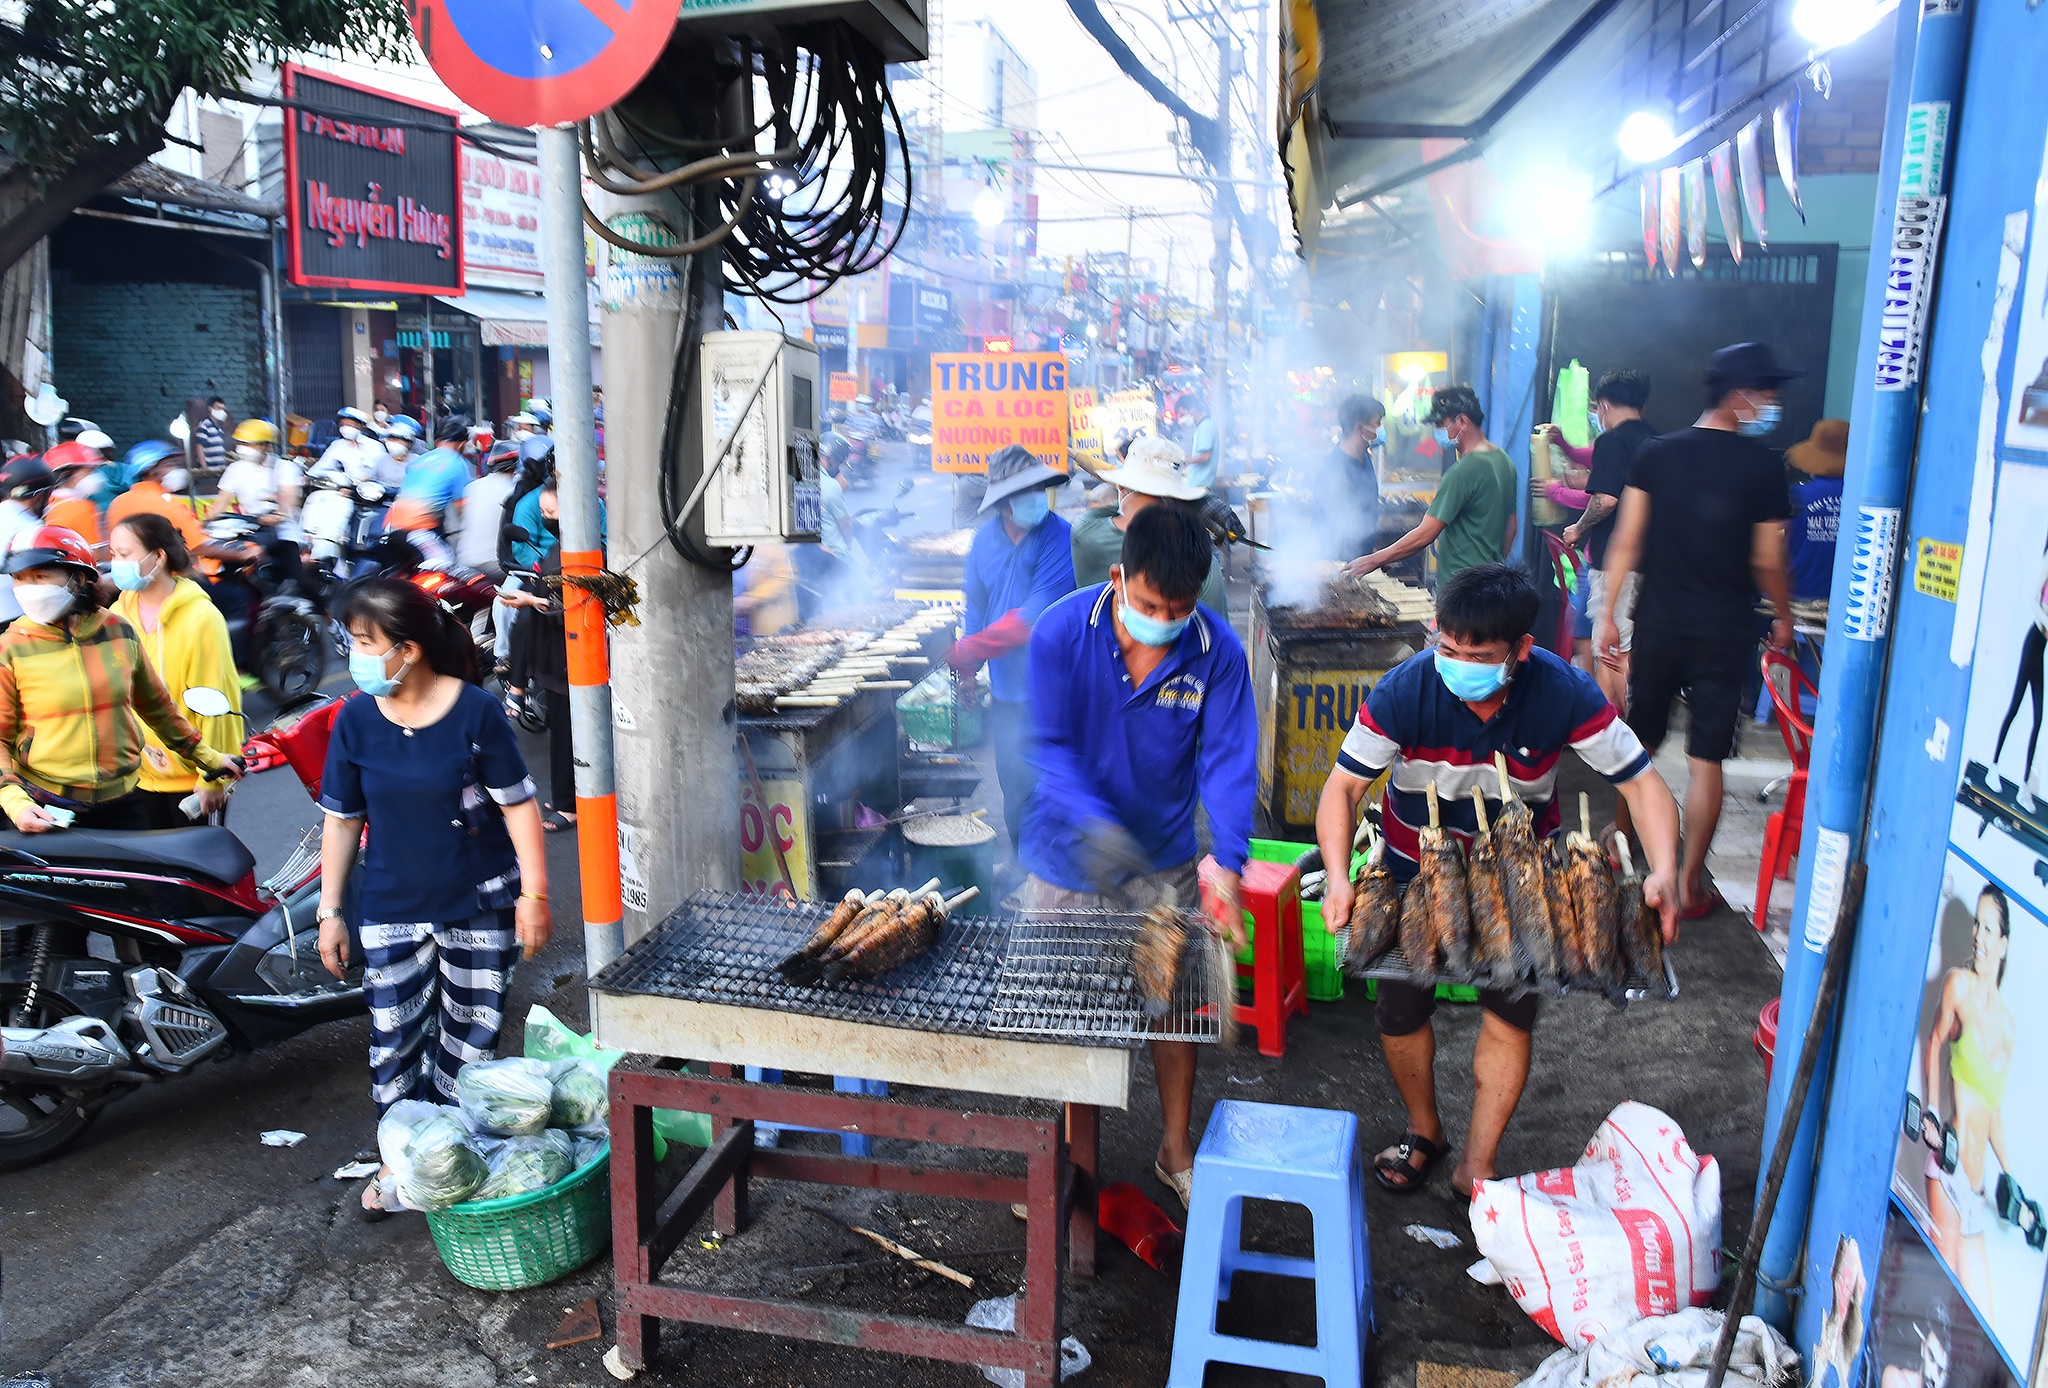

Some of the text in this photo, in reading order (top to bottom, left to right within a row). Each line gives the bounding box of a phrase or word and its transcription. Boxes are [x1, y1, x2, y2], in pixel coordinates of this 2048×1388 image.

[936, 361, 1065, 391] TRUNG
[944, 393, 1055, 418] CÁ LÓC
[1292, 683, 1371, 732] TRU
